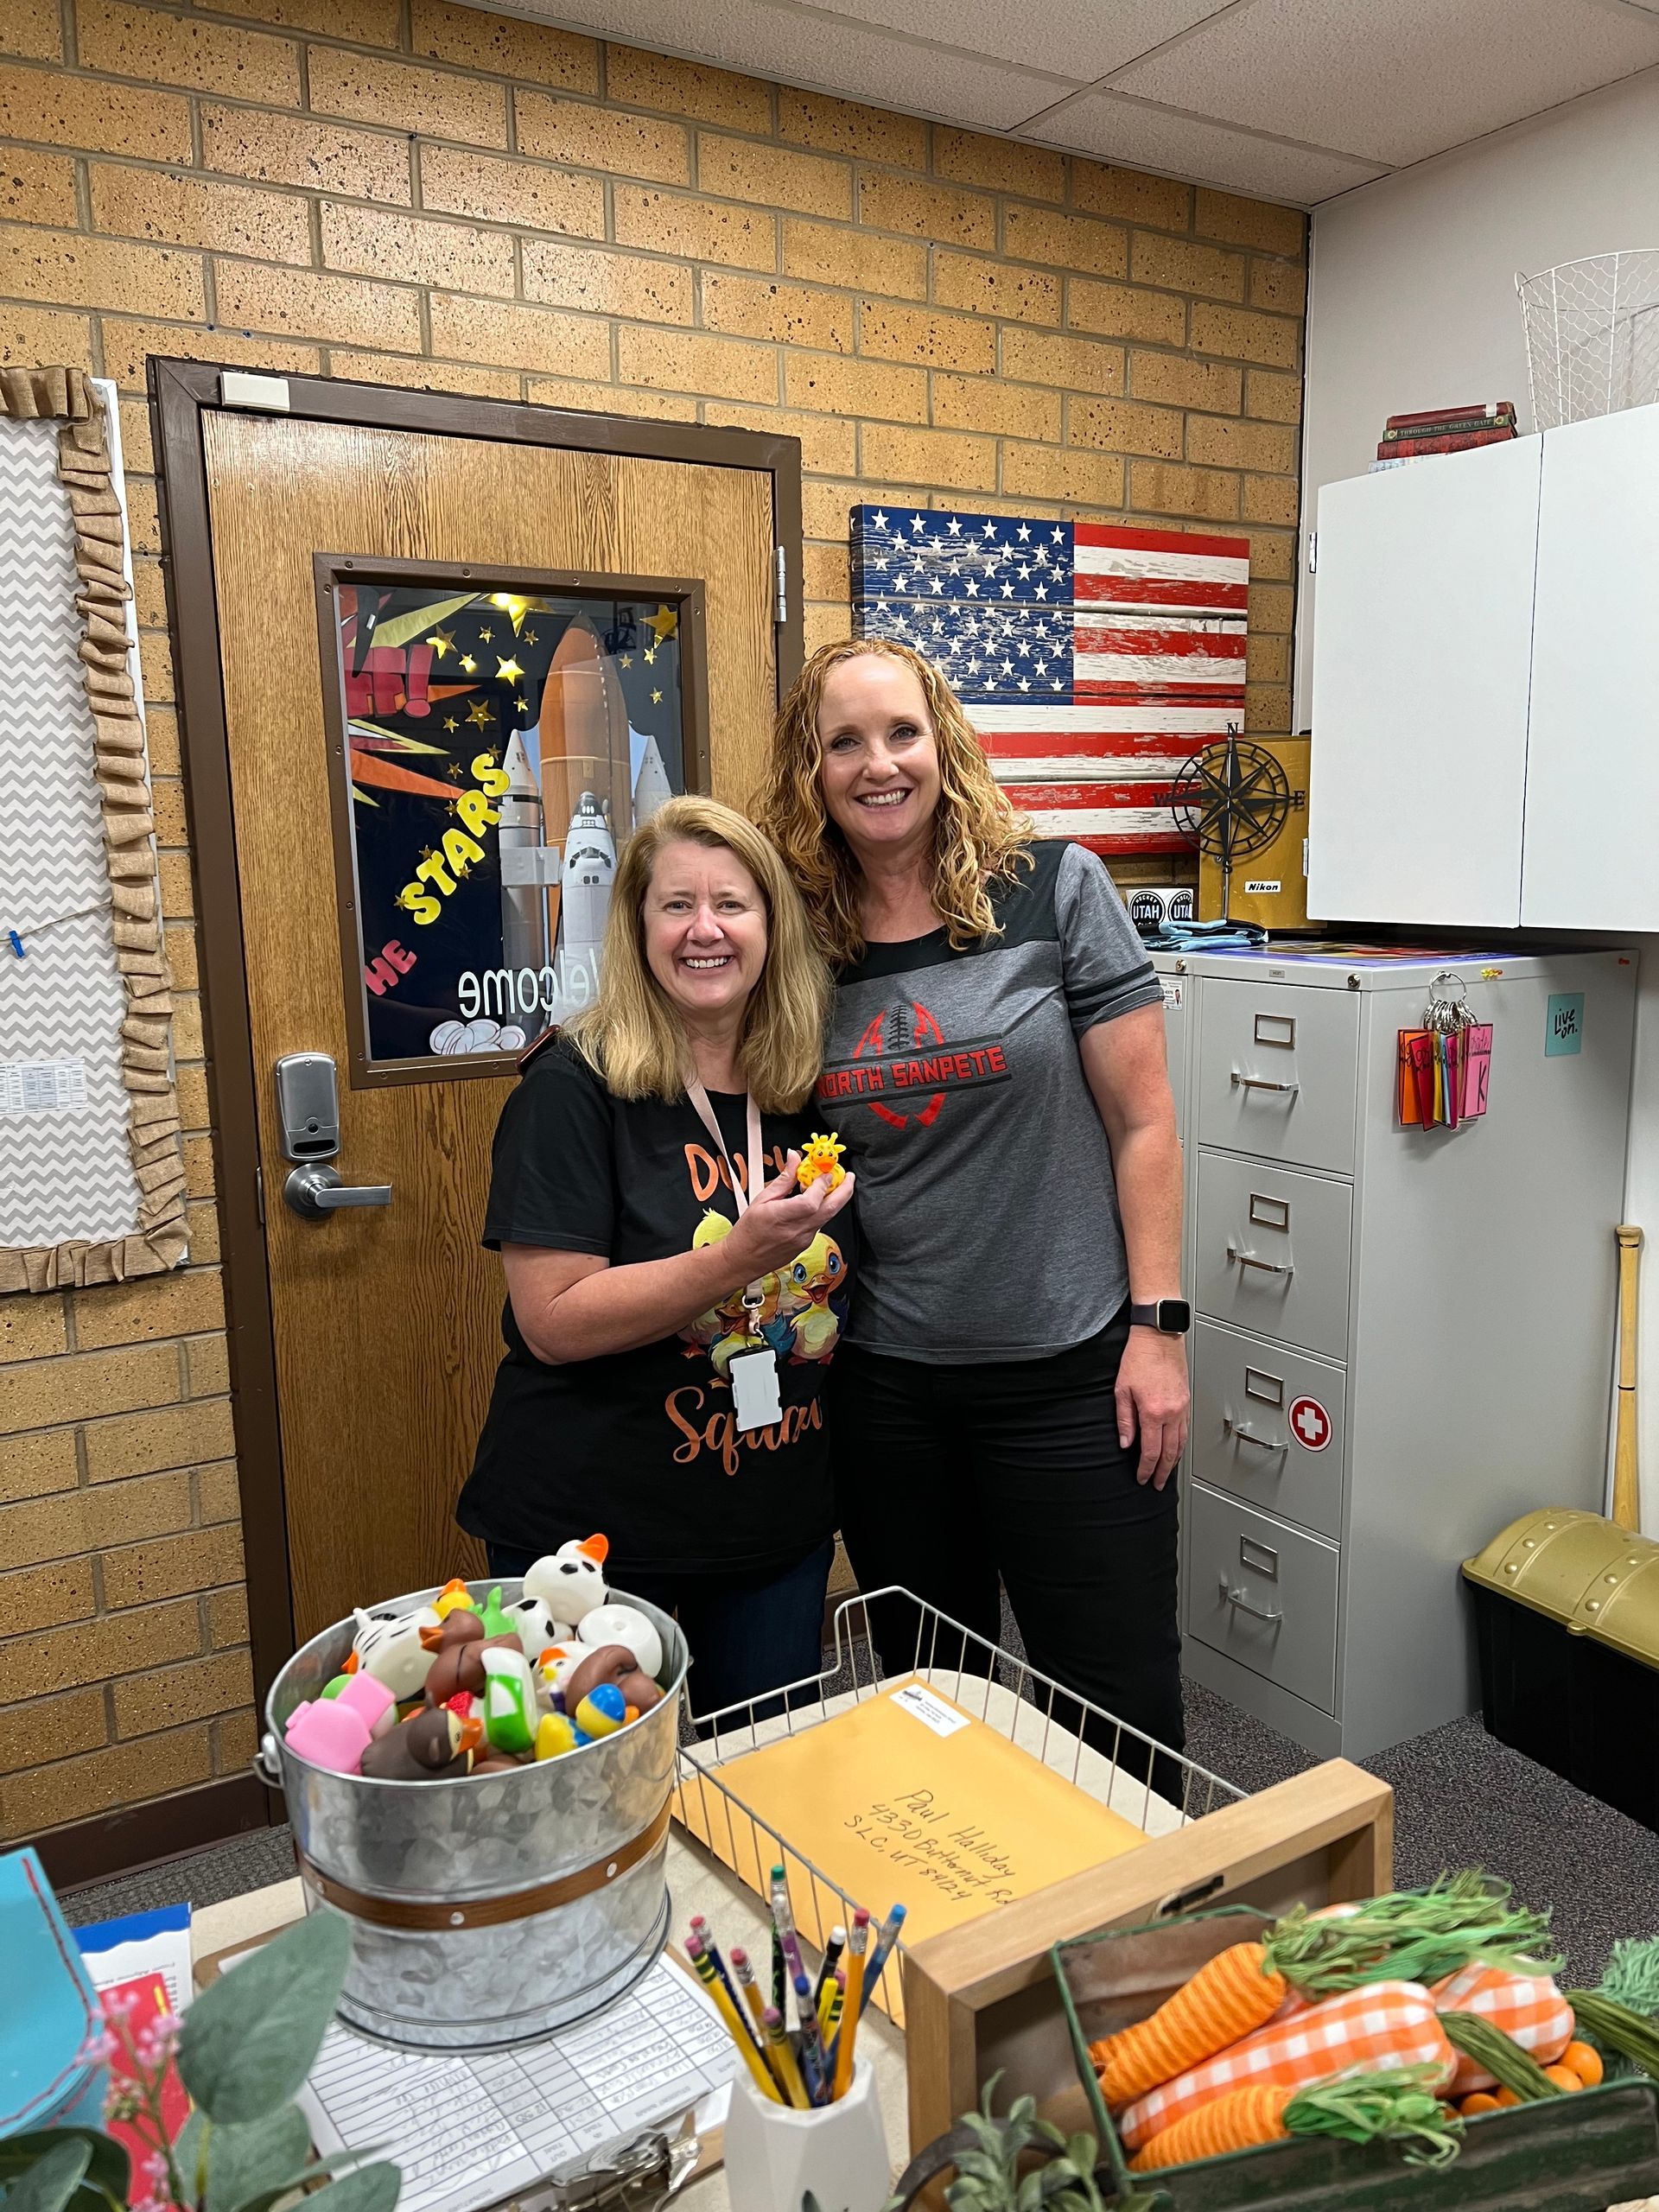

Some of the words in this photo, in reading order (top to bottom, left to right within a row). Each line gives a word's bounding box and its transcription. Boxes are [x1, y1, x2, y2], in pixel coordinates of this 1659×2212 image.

[1400, 426, 1432, 437] THROUGH
[1433, 424, 1446, 433] THE
[1294, 790, 1306, 805] E
[401, 753, 510, 925] STARS
[1135, 894, 1158, 904] HOCKEY
[1133, 905, 1160, 918] UTAH
[1554, 1007, 1575, 1035] Live
[1561, 1023, 1578, 1039] on.
[890, 1046, 1007, 1089] SANPETE
[1477, 1060, 1487, 1113] K
[868, 1803, 922, 1840] 4330
[894, 1789, 950, 1824] Paul
[947, 1826, 1016, 1879] Halliday
[843, 1815, 888, 1853] SLC,
[890, 1850, 929, 1866] UT
[918, 1867, 972, 1901] 84124
[658, 2085, 690, 2106] STUDENT
[634, 2102, 658, 2118] NAME
[550, 2150, 567, 2162] OUT
